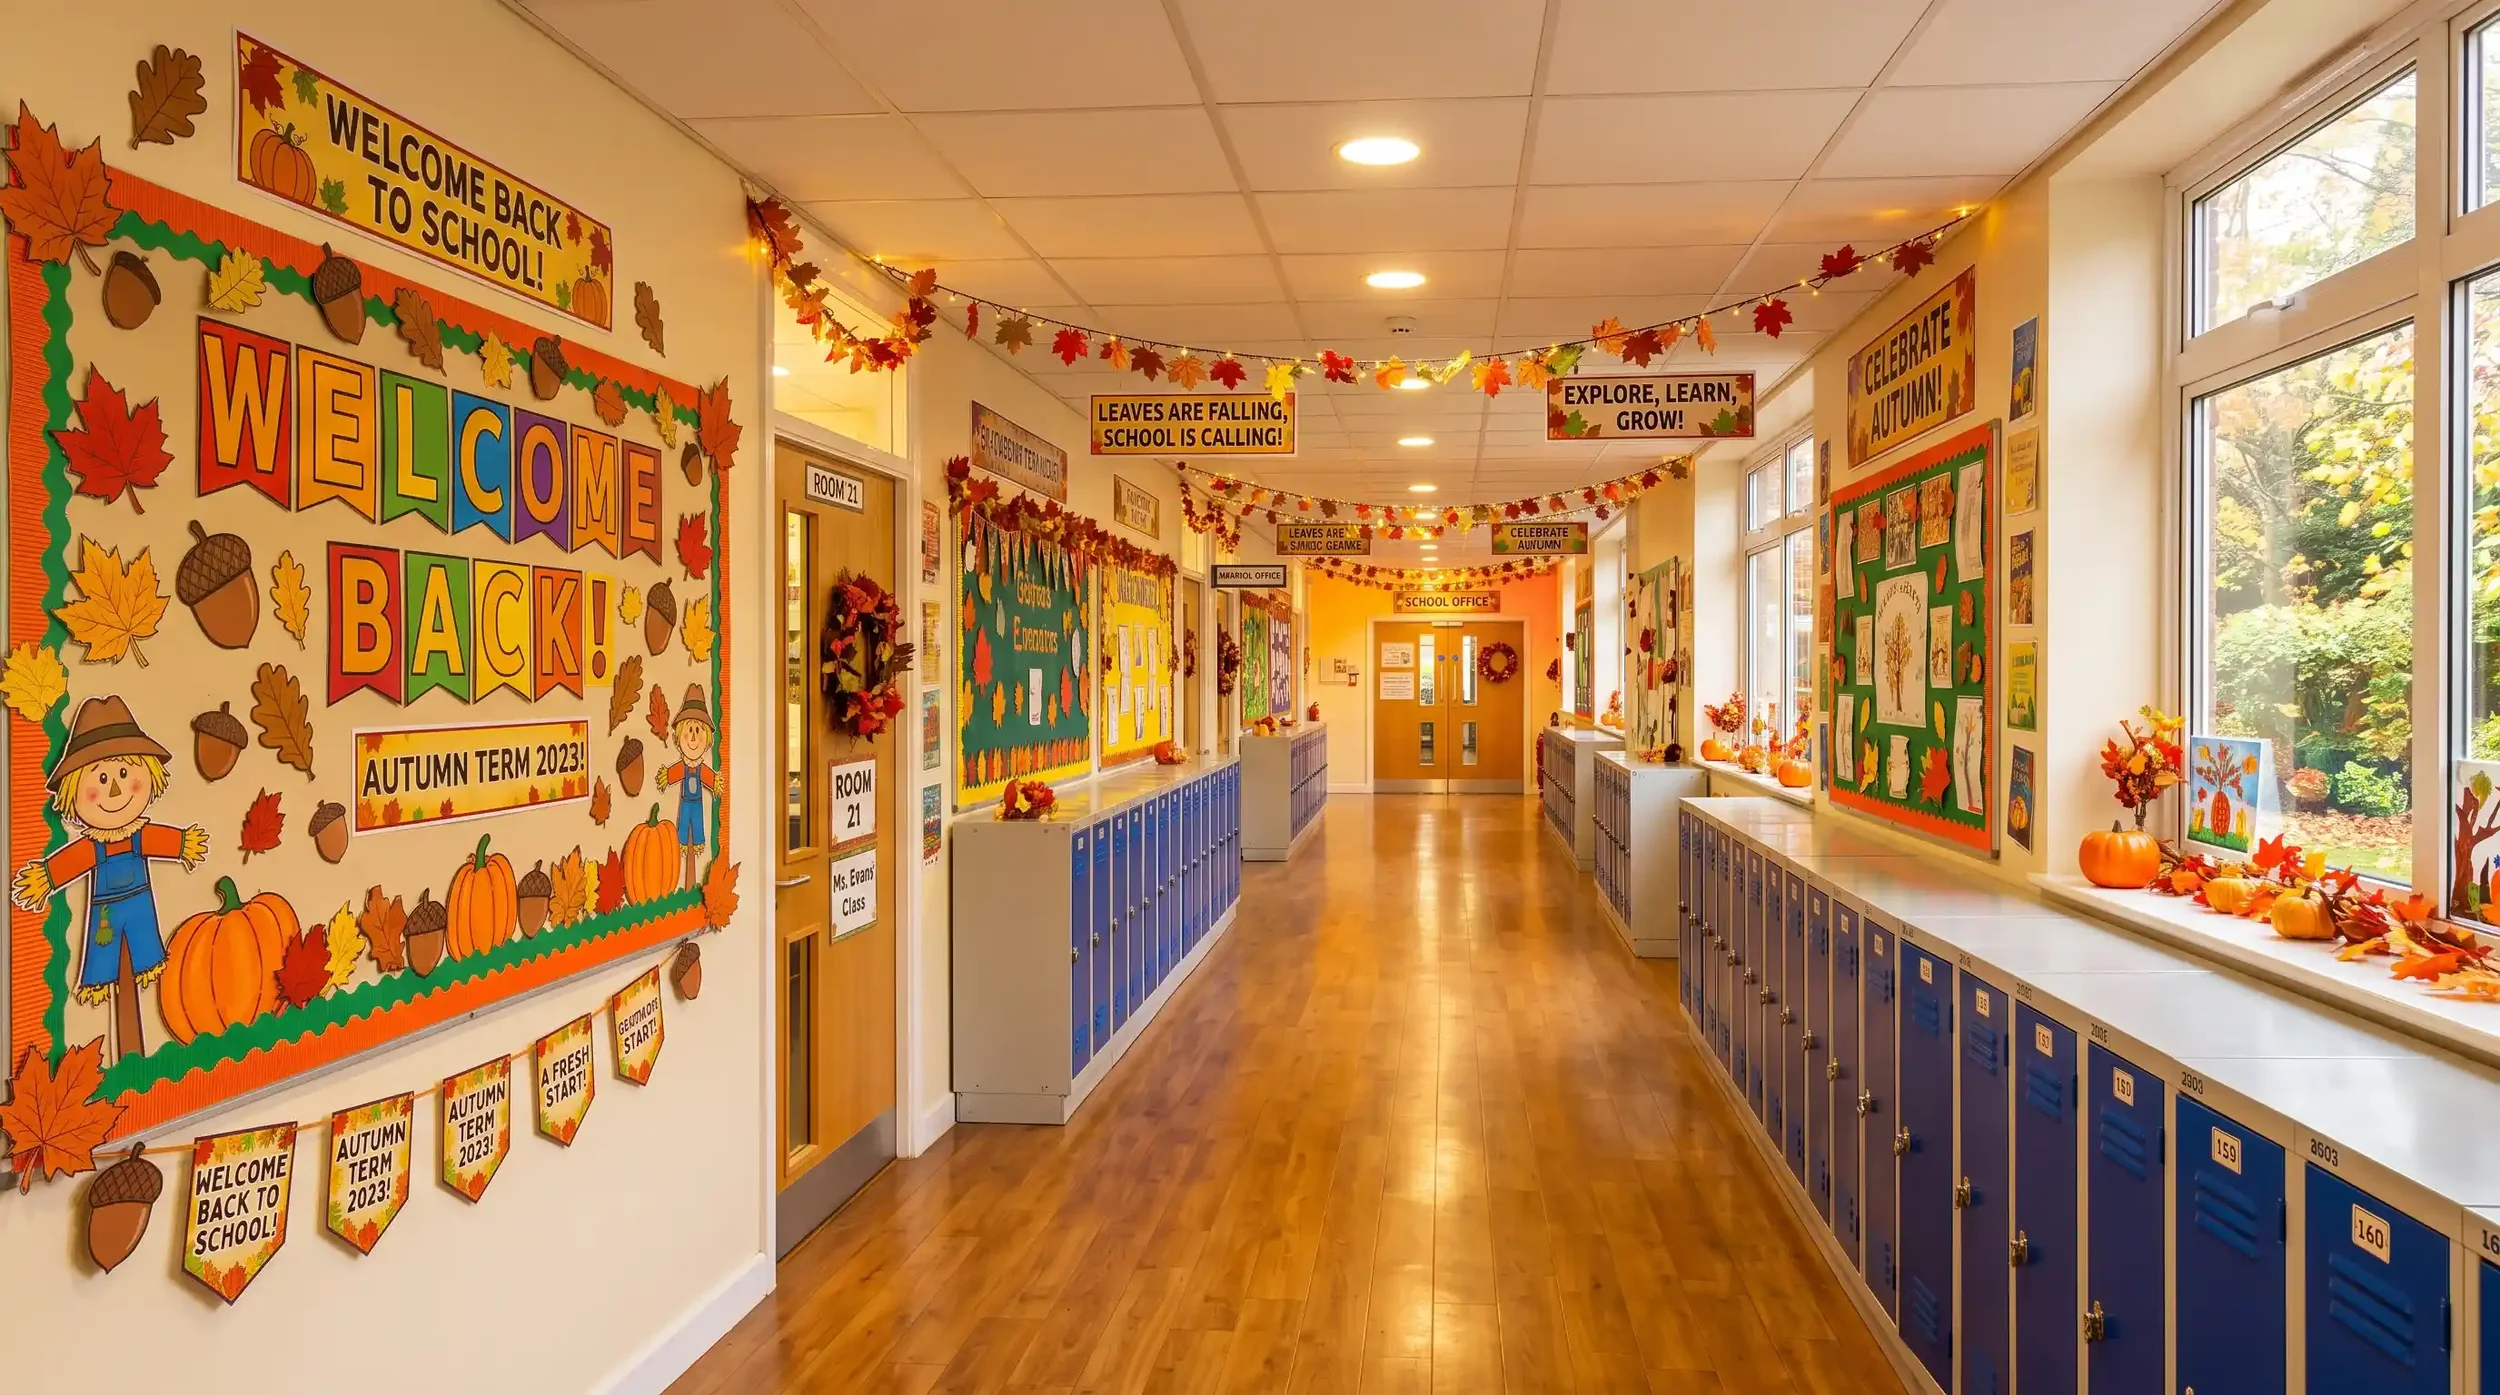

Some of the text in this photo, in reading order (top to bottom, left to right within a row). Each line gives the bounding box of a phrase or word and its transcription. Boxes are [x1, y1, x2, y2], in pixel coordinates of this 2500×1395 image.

[326, 92, 563, 251] WELCOME BACK
[367, 174, 544, 292] TO SCHOOL!
[1865, 299, 1951, 396] CELEBRATE
[1564, 382, 1737, 407] EXPLORE, LEARN,
[1871, 363, 1942, 444] AUTUMN!
[1099, 401, 1288, 424] LEAVES ARE FALLING,
[1617, 410, 1684, 430] GROW!
[201, 332, 657, 542] WELCOME
[1104, 428, 1283, 447] SCHOOL IS CALLING!
[814, 473, 858, 504] ROOM 21
[1289, 528, 1344, 538] LEAVES ARE
[1511, 527, 1568, 537] CELEBRATE
[339, 555, 607, 680] BACK!
[1405, 597, 1489, 607] SCHOOL OFFICE
[362, 742, 585, 797] AUTUMN TERM 2023!
[836, 769, 872, 800] ROOM
[847, 802, 861, 829] 21
[833, 873, 848, 893] Ms.
[842, 896, 866, 917] Class
[624, 1016, 658, 1055] START!
[541, 1045, 590, 1088] A FRESH
[448, 1081, 506, 1123] AUTUMN
[546, 1069, 587, 1107] START!
[336, 1120, 406, 1162] AUTUMN
[458, 1109, 494, 1142] TERM
[459, 1133, 494, 1167] 2023!
[2217, 1138, 2237, 1163] 159
[195, 1153, 289, 1196] WELCOME
[349, 1151, 393, 1185] TERM
[196, 1184, 280, 1226] BACK TO
[347, 1178, 391, 1213] 2023!
[195, 1212, 278, 1256] SCHOOL!
[2358, 1219, 2384, 1250] 160
